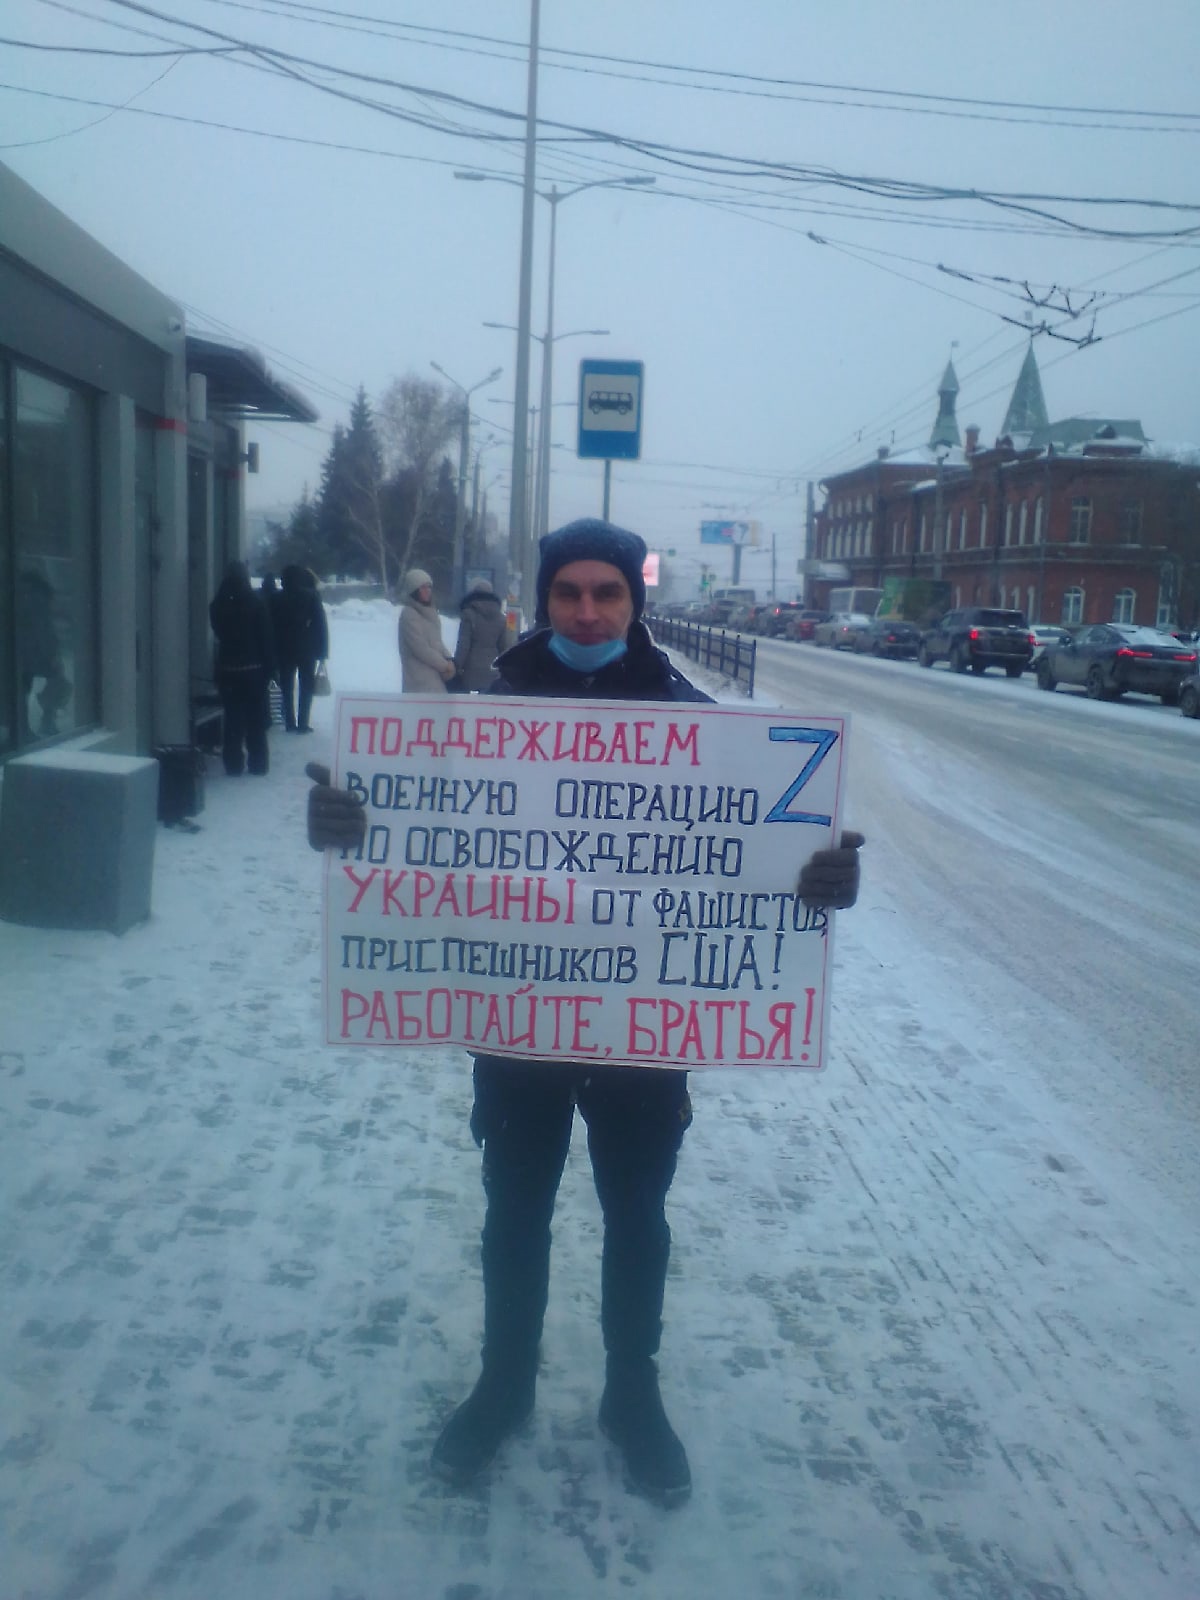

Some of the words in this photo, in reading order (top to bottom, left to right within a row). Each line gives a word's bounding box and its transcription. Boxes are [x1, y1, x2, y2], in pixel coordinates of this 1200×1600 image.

[350, 716, 701, 766] ПОДДЕРЖИВАЕМ
[346, 771, 517, 816] ВОЕННУЮ
[556, 778, 758, 831] ОПЕРАЦИЮ
[764, 727, 840, 827] Z
[405, 827, 743, 877] ОСВОБОЖДЕНИЮ
[343, 866, 576, 924] УКРАИНЫ
[592, 889, 642, 927] ОТ
[341, 935, 638, 983] ПРИСПЕШНИКОВ
[658, 932, 785, 990] США!
[340, 984, 613, 1057] РАБОТАЙТЕ,
[626, 987, 816, 1061] БРАТЬЯ!
